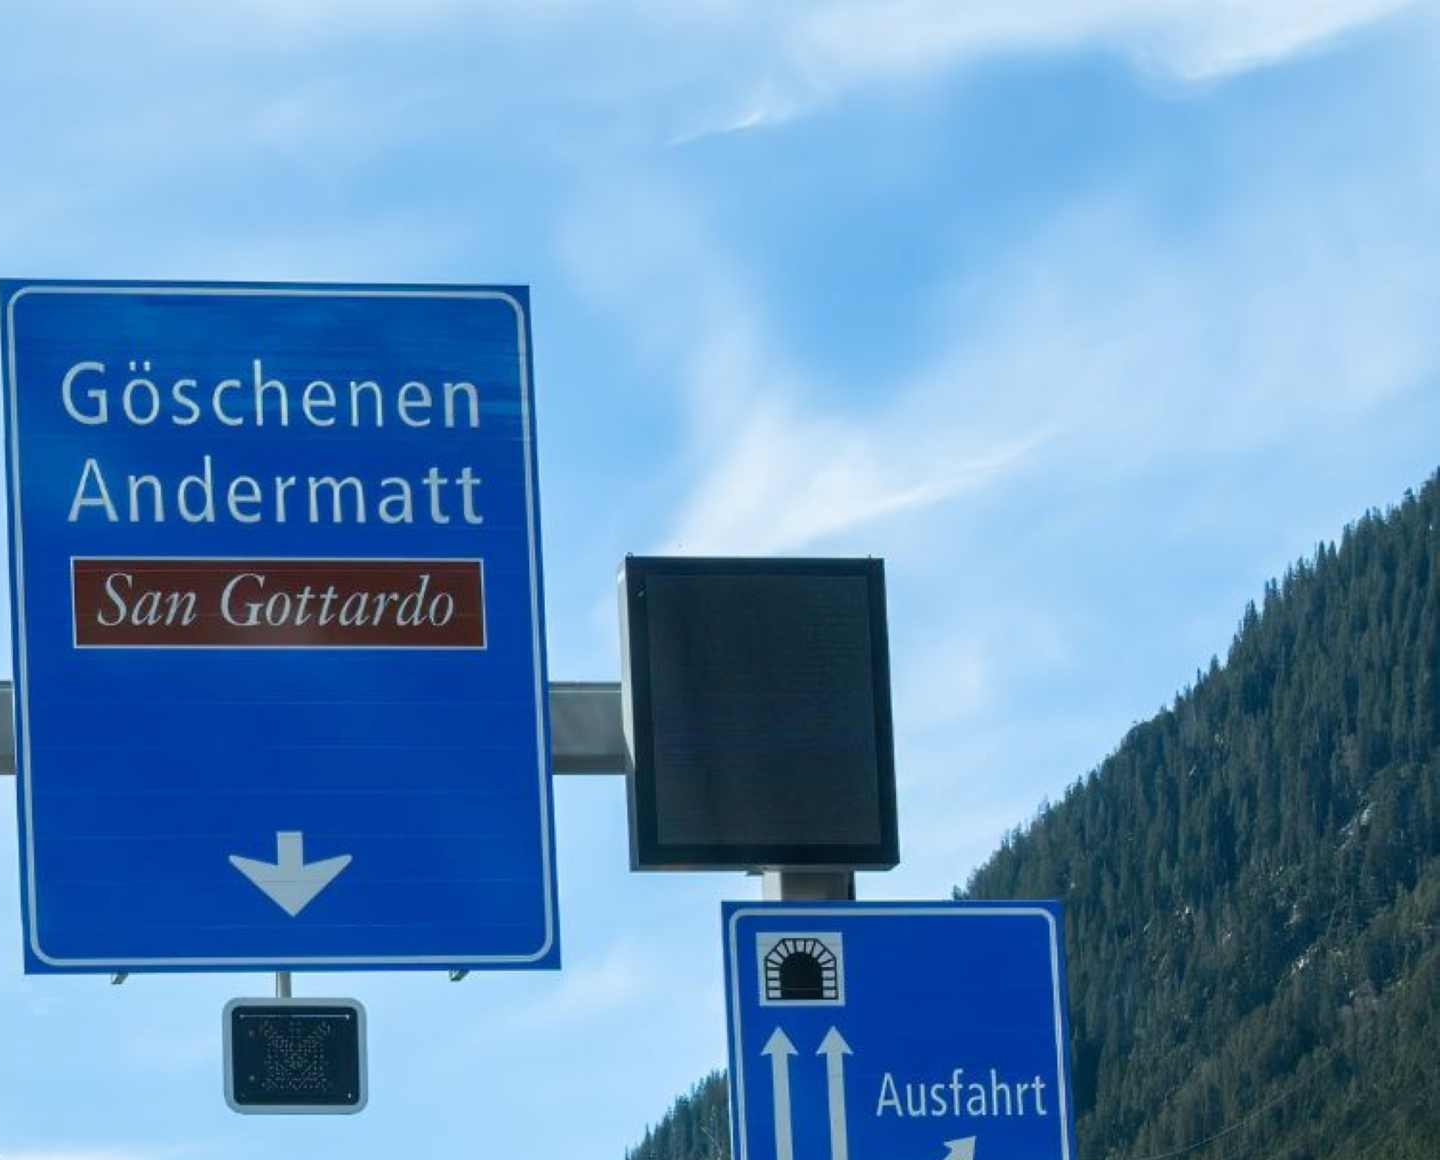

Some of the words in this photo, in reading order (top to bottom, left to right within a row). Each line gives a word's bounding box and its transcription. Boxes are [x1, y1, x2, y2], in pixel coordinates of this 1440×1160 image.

[61, 359, 481, 428] Göschenen
[67, 455, 484, 524] Andermatt
[96, 572, 198, 628] San
[219, 572, 456, 628] Gottardo
[875, 1069, 1048, 1119] Ausfahrt
